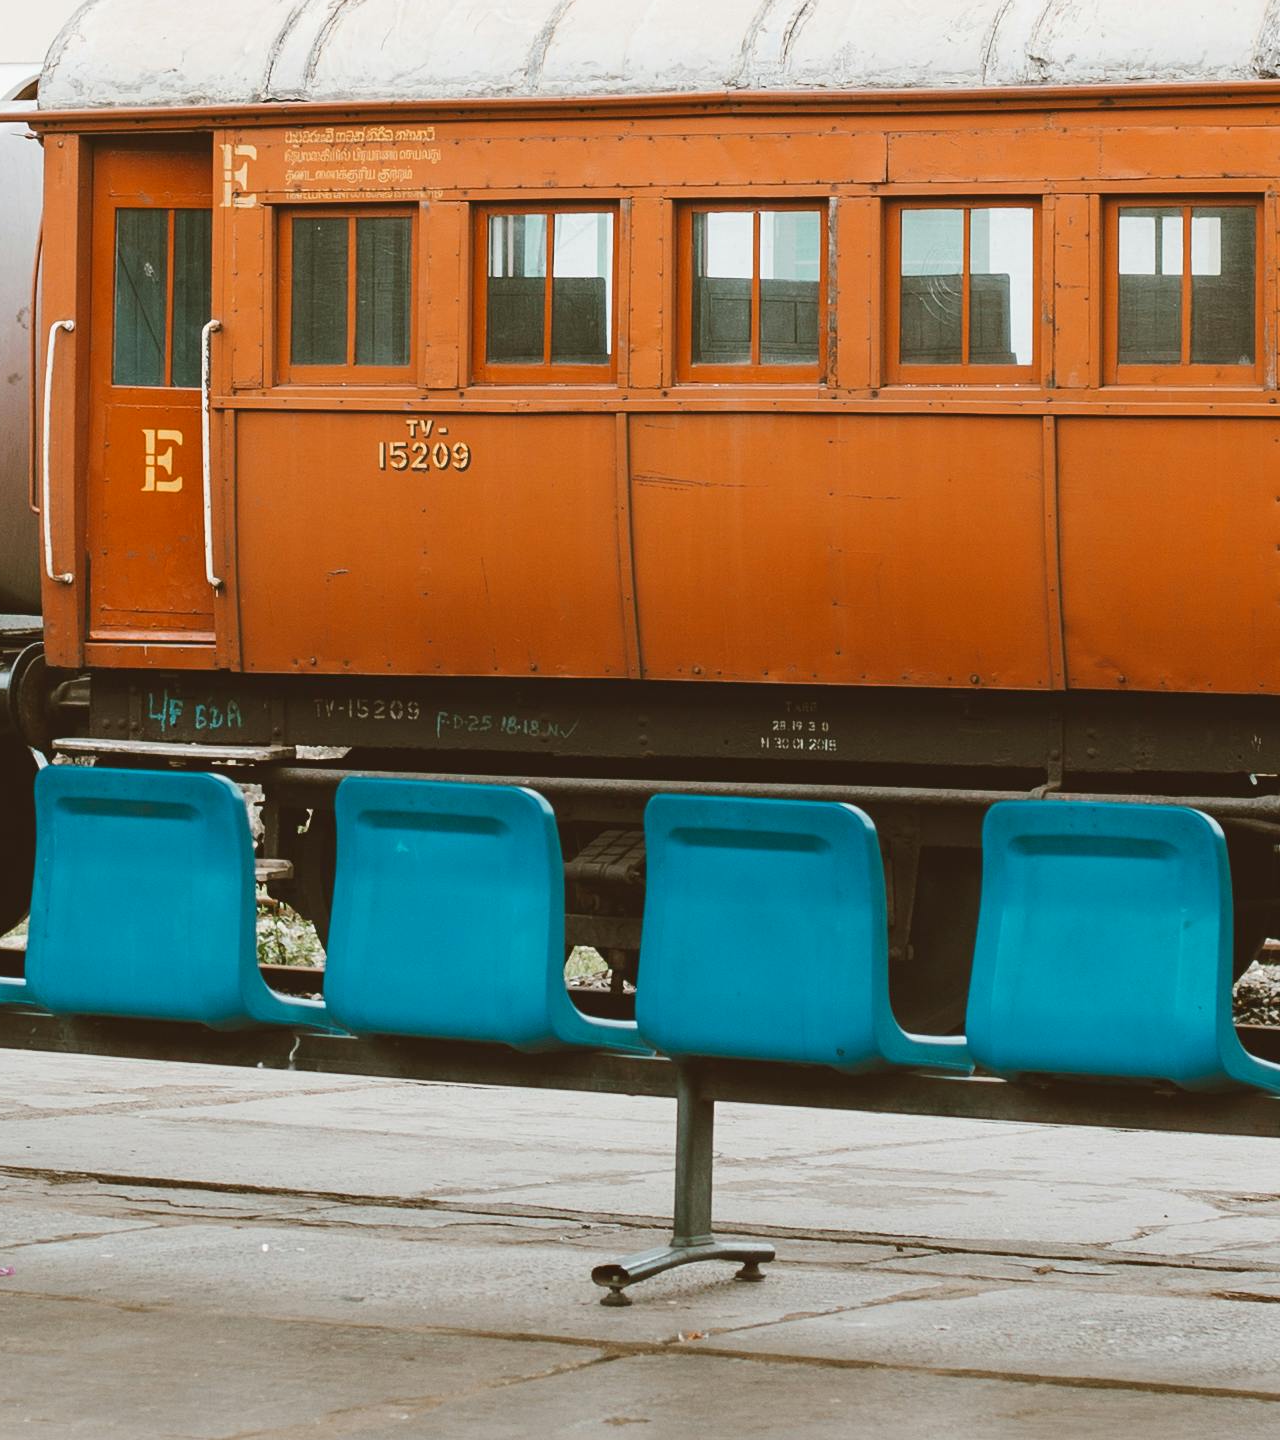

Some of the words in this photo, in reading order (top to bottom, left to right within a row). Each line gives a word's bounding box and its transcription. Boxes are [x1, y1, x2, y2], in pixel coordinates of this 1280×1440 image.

[219, 144, 257, 208] E
[141, 428, 184, 493] E
[378, 440, 472, 473] 15209
[313, 698, 420, 720] TV-15209
